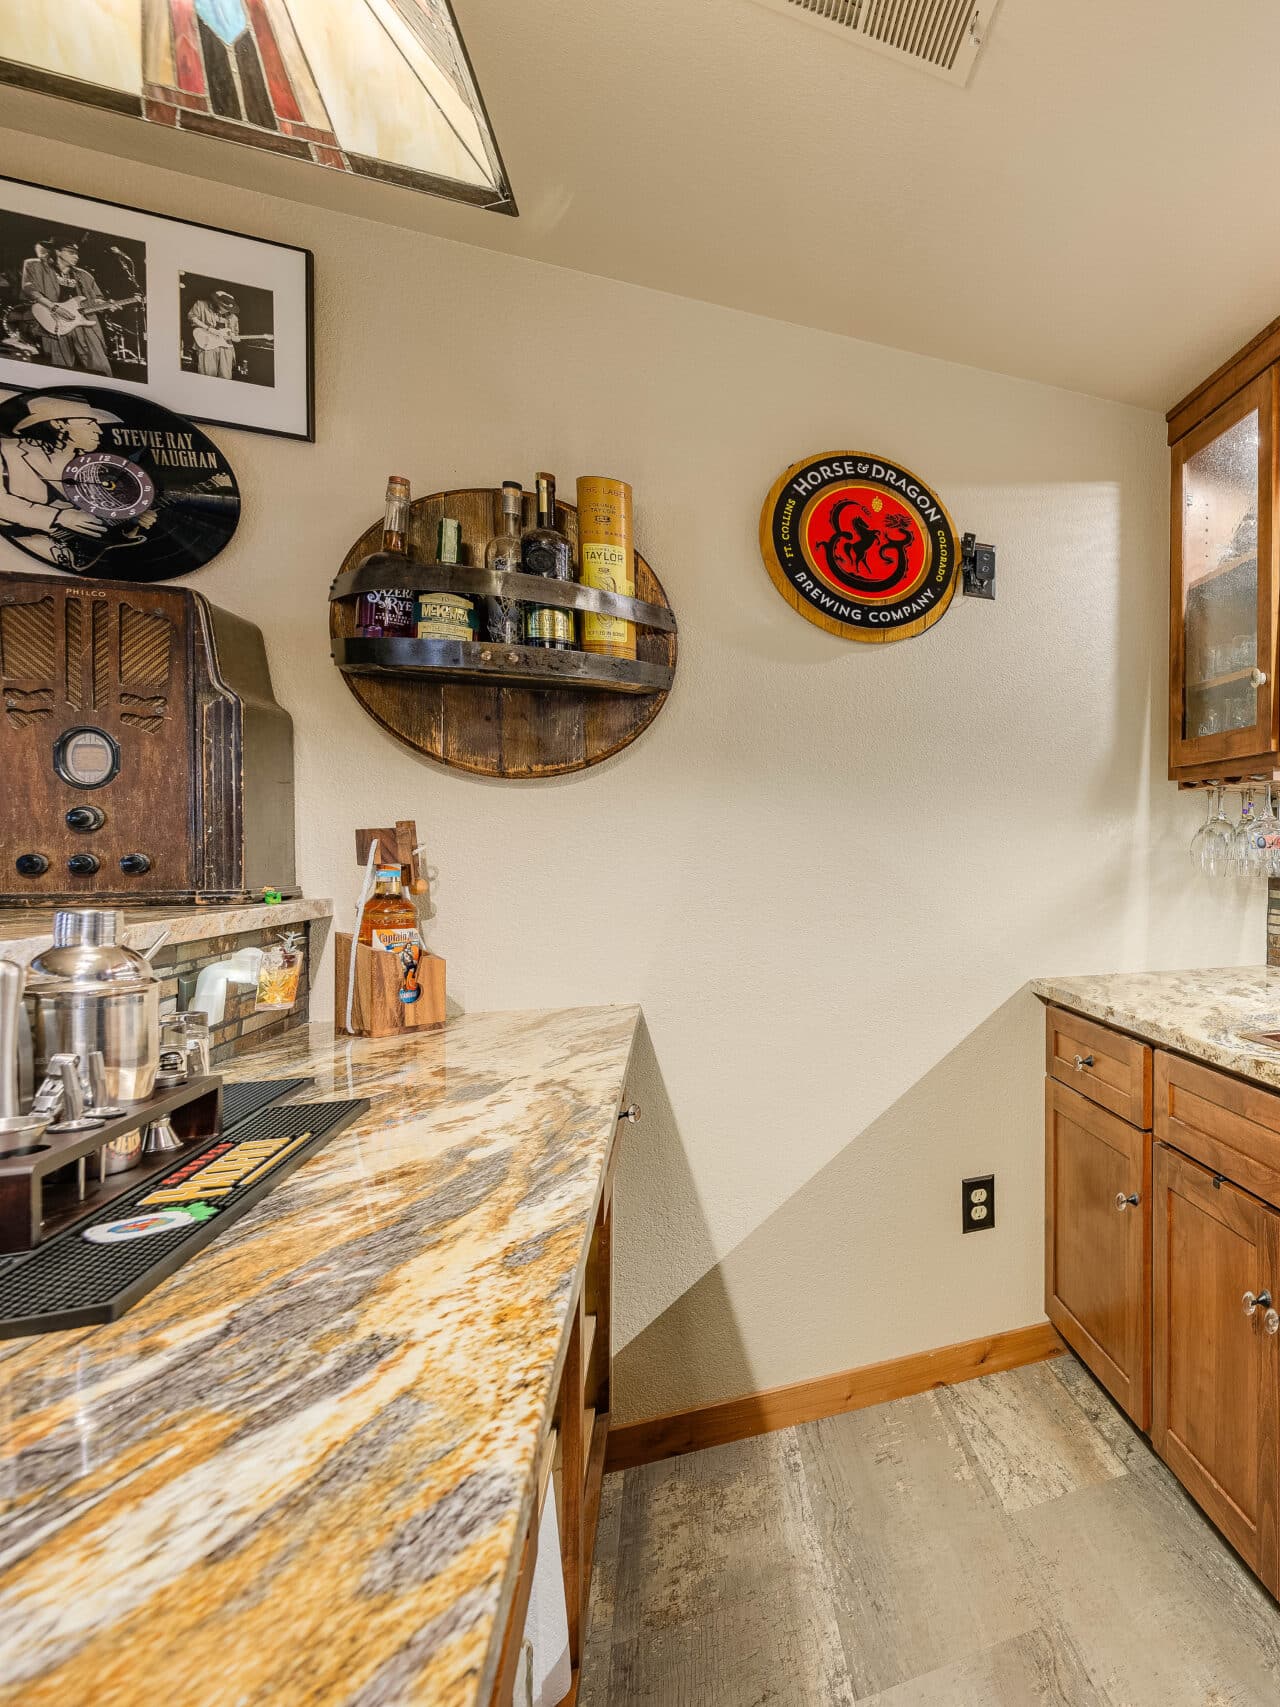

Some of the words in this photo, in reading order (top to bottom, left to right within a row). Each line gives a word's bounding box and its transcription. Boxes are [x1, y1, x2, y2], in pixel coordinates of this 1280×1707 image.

[111, 428, 165, 448] STEVIE
[165, 432, 193, 450] RAY
[150, 448, 218, 469] VAUGHAN
[793, 461, 856, 497] HORSE
[857, 463, 869, 474] &
[871, 464, 941, 522] DRAGON
[781, 498, 796, 541] COLLINS
[585, 551, 624, 563] TAYLOR
[783, 543, 793, 559] FT.
[936, 530, 948, 583] COLORADO
[65, 588, 106, 598] PHILCO
[794, 571, 862, 621] BREWING
[868, 588, 935, 623] COMPANY
[380, 931, 407, 943] Captain
